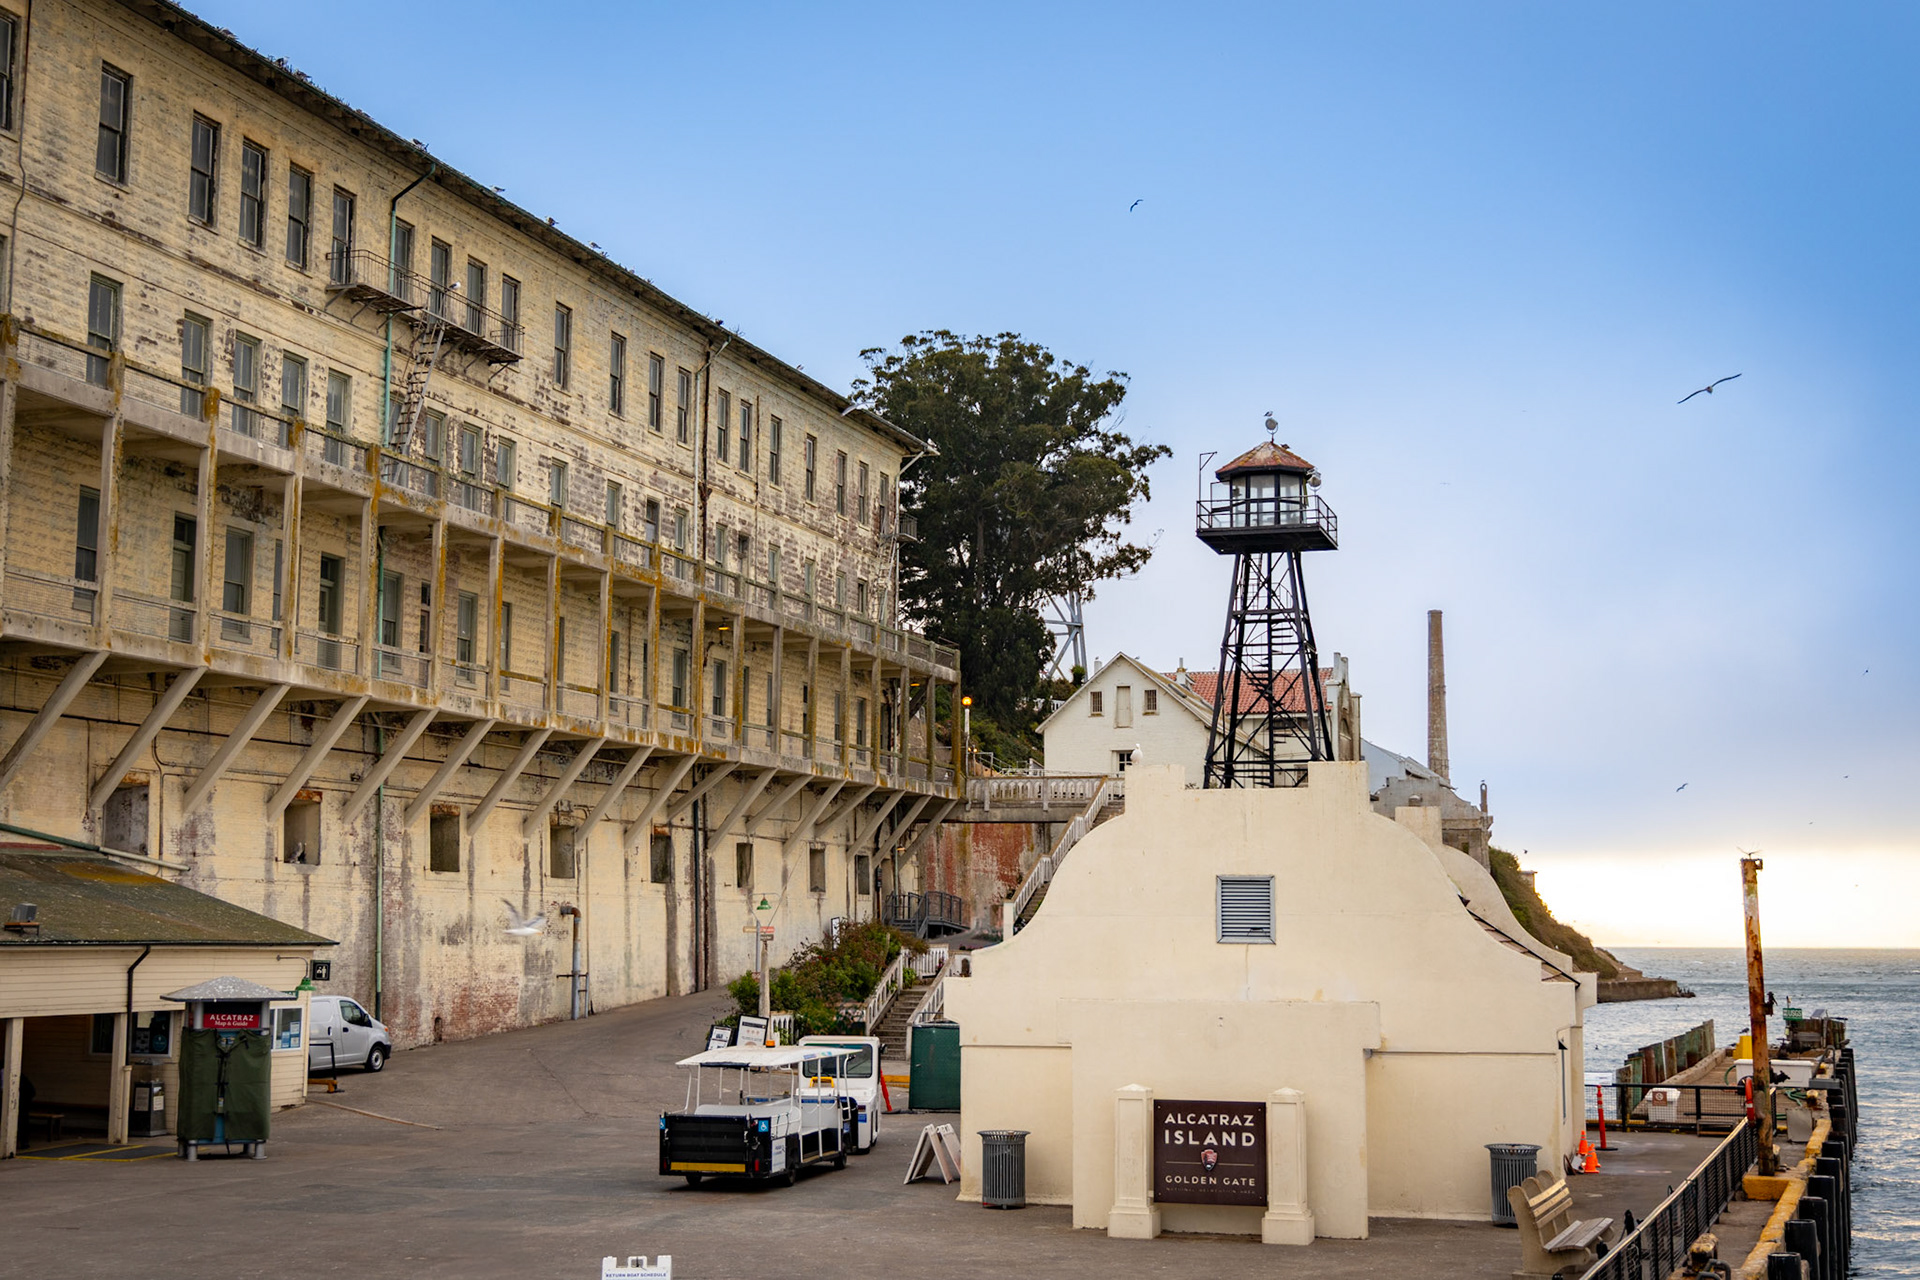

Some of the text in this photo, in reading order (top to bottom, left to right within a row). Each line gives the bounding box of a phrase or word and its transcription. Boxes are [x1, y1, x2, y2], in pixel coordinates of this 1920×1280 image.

[1164, 1113, 1255, 1127] ALCATRAZ
[1164, 1129, 1255, 1147] ISLAND
[1165, 1175, 1256, 1187] GOLDEN GATE
